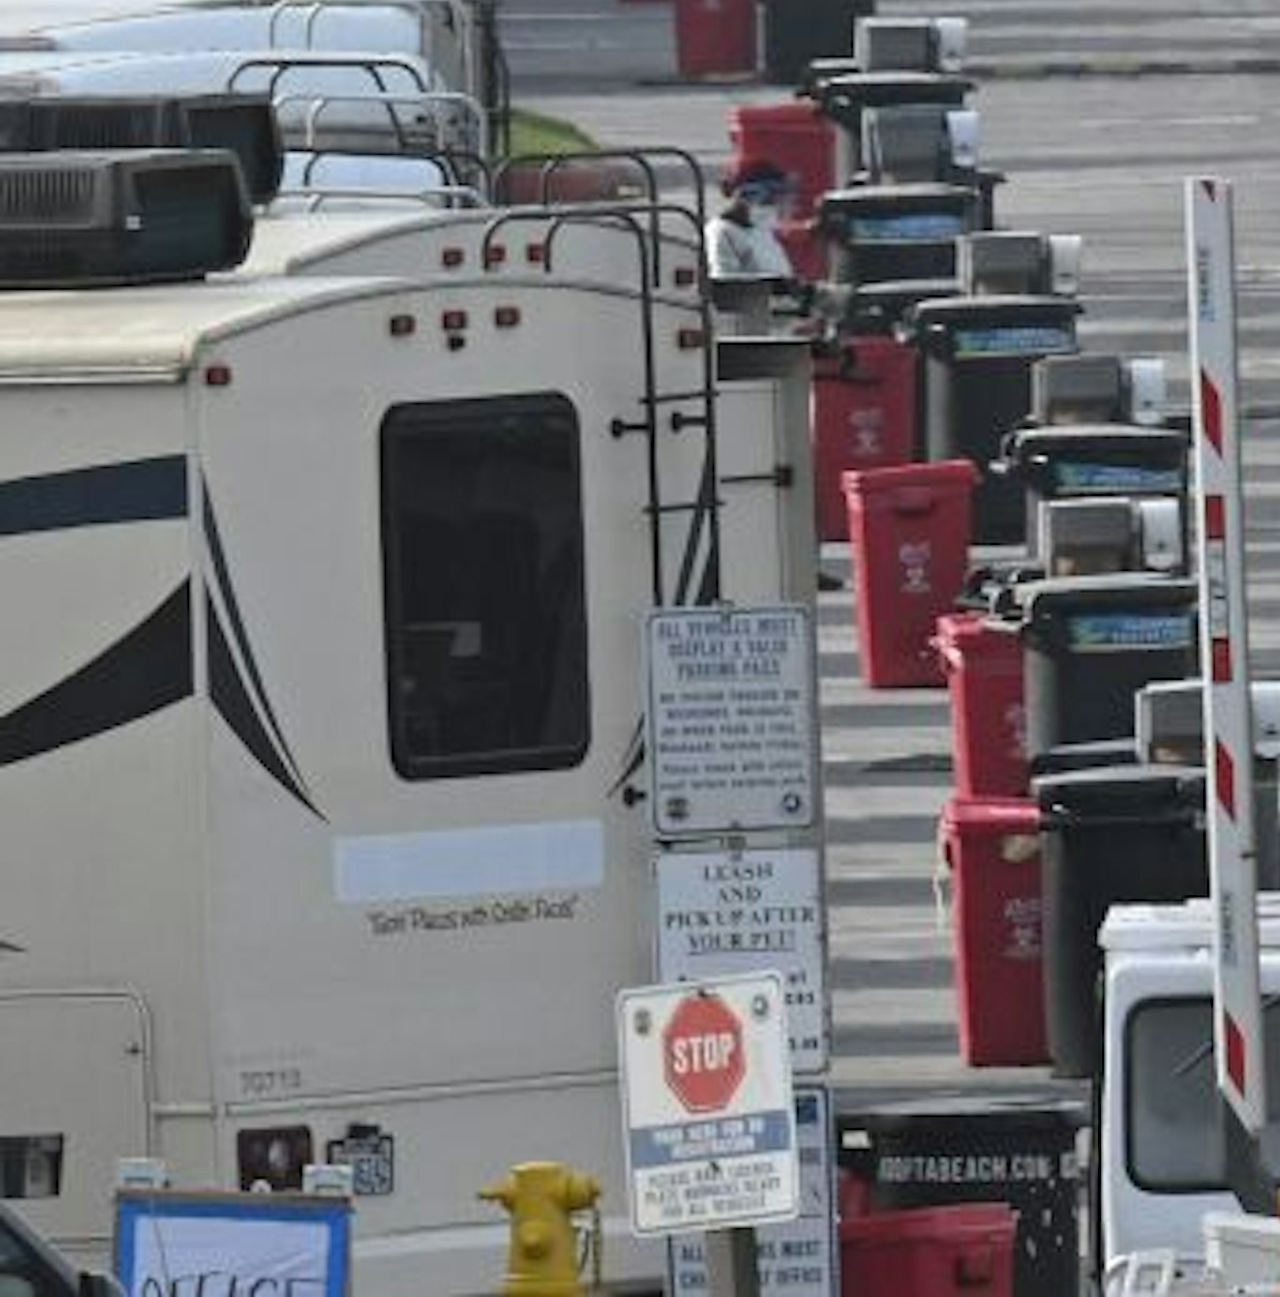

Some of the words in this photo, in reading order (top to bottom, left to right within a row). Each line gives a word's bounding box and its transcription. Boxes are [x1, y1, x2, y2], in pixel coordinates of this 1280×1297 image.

[704, 862, 774, 881] LEASH
[719, 886, 762, 903] AND
[753, 906, 815, 924] AFTER
[687, 932, 742, 949] YOUR
[672, 1032, 735, 1075] STOP
